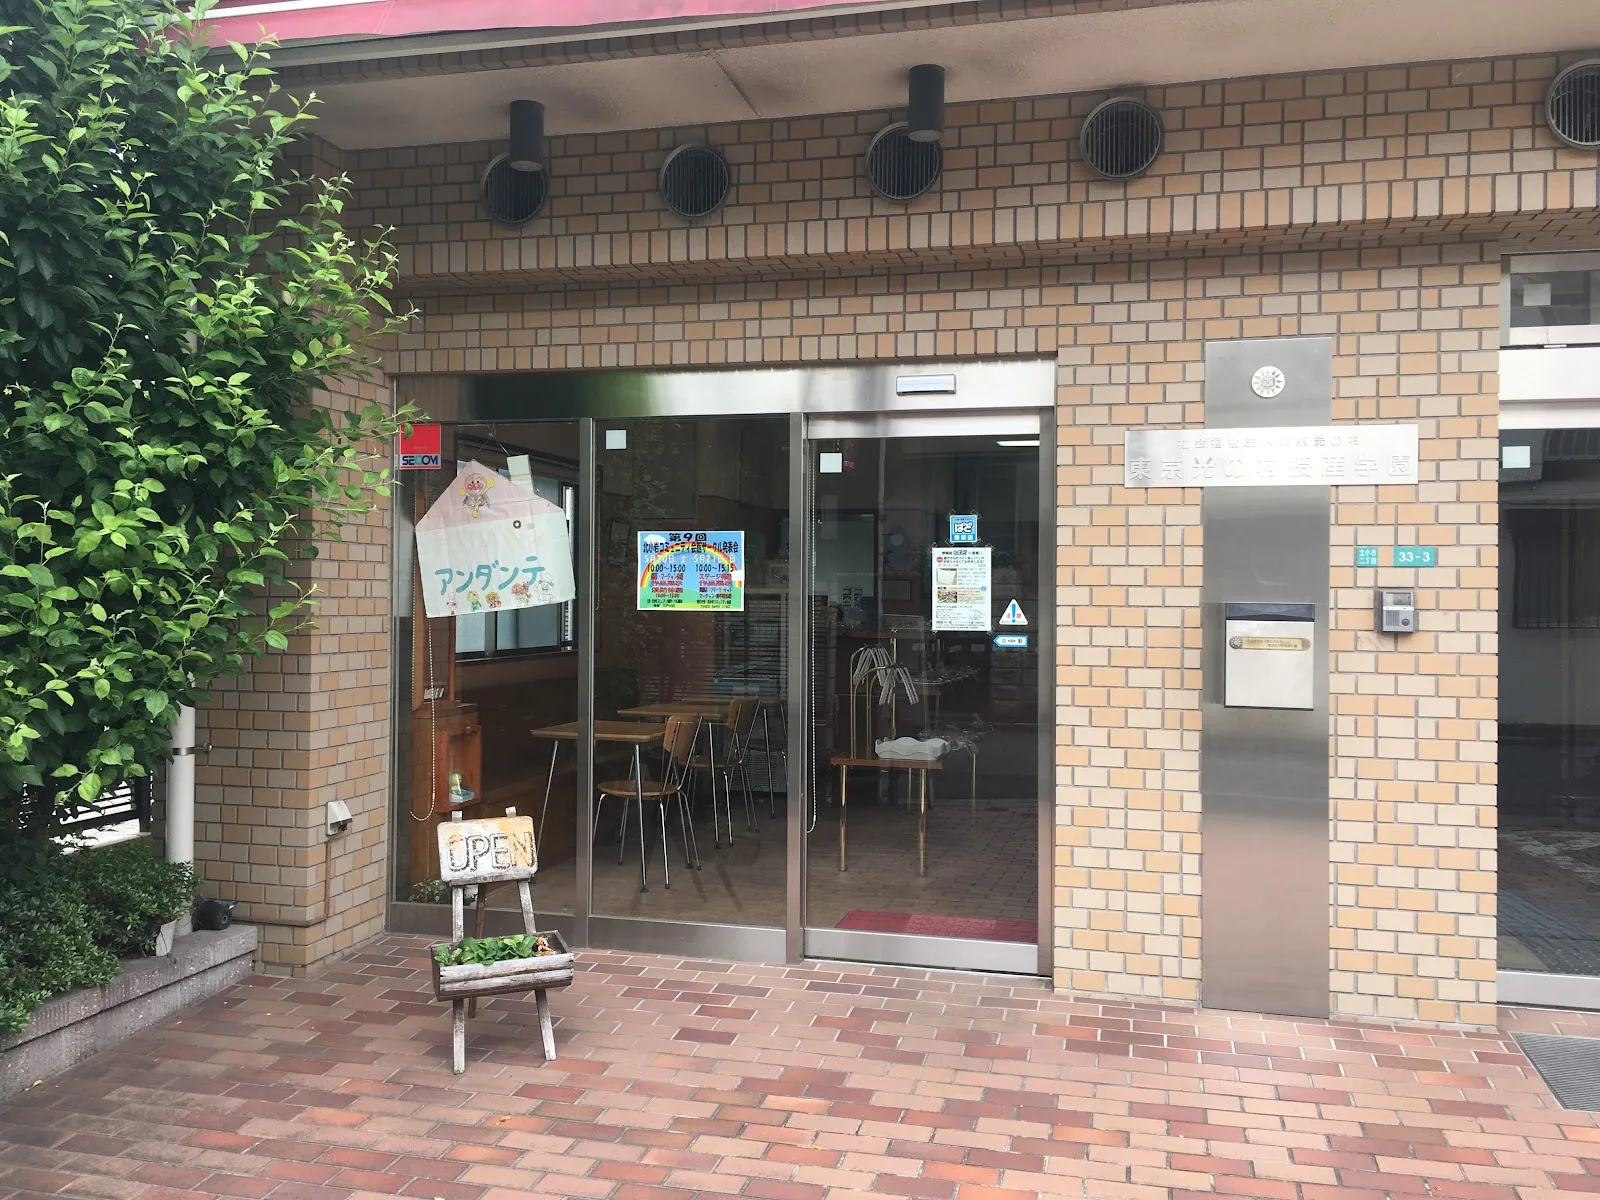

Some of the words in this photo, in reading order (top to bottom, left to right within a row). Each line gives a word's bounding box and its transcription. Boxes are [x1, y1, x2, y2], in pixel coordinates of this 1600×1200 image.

[402, 455, 438, 465] SECOM
[1129, 453, 1412, 480] 東京光の村授産学園
[669, 533, 707, 542] 第9回
[1398, 551, 1431, 563] 33-3
[435, 556, 545, 596] アンダンテ
[446, 831, 536, 872] OPEN
